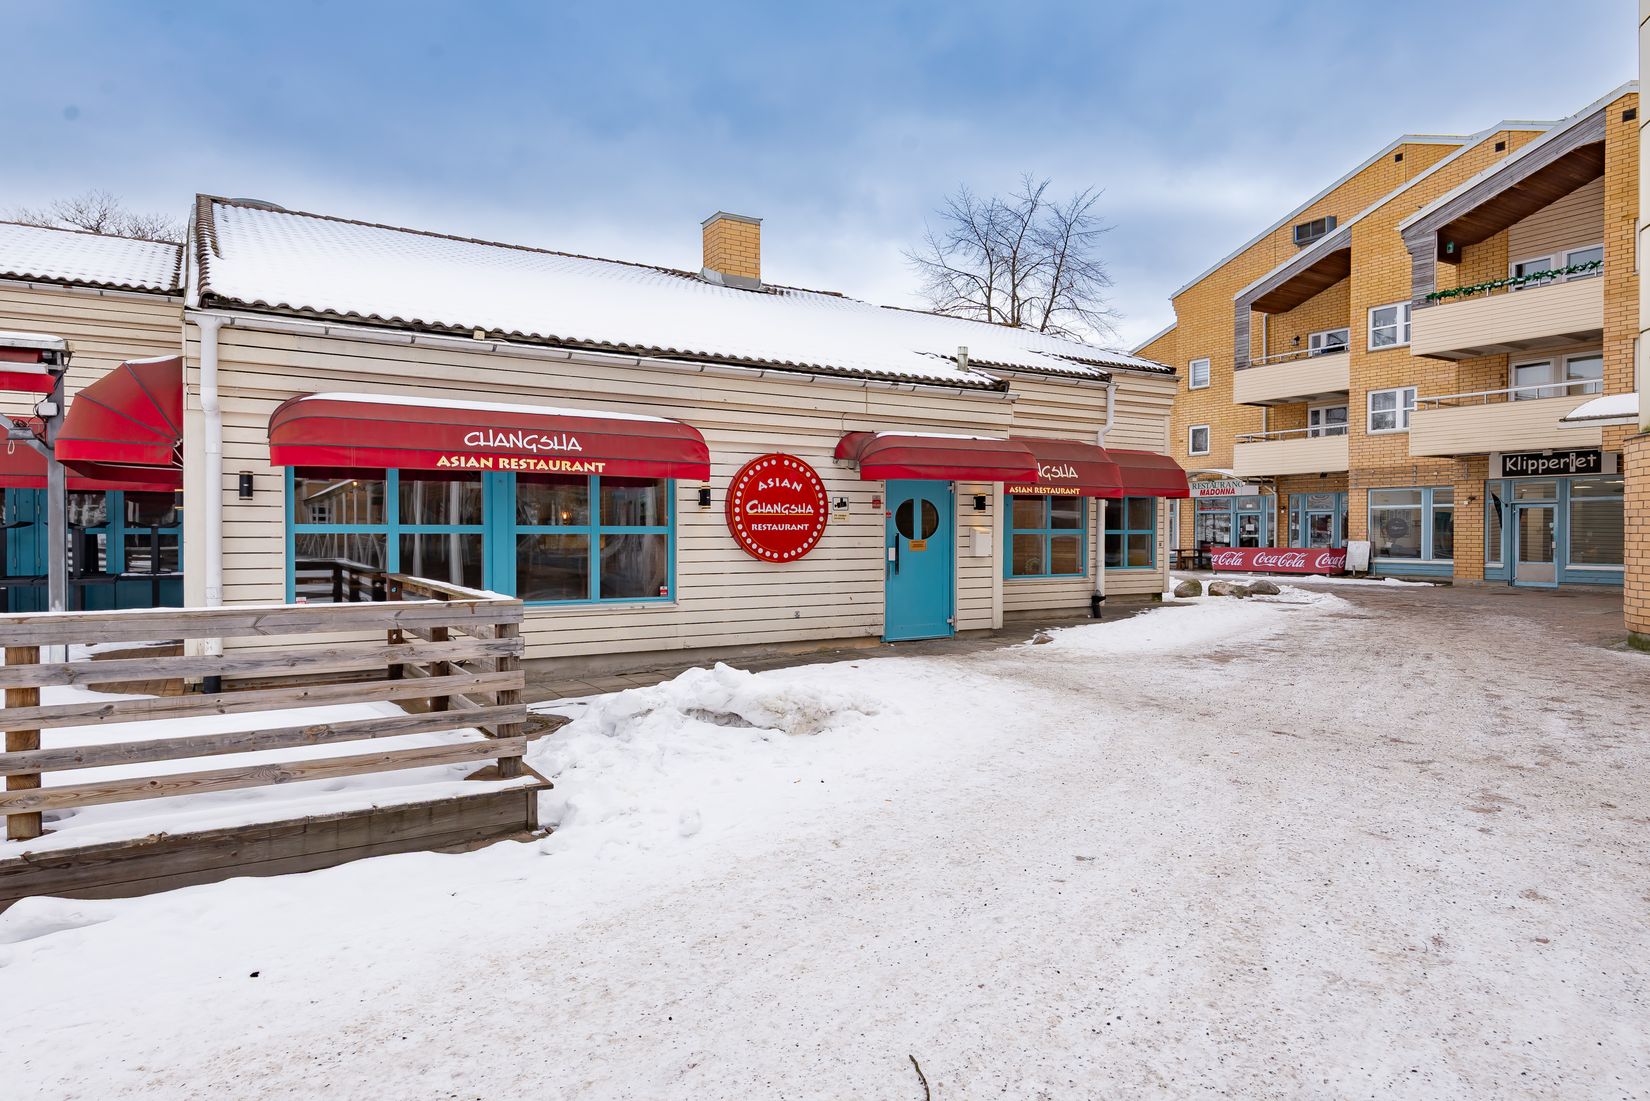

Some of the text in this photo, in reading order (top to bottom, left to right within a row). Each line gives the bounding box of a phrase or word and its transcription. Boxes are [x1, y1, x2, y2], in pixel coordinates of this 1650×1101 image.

[464, 429, 583, 453] CHANGSHA
[436, 455, 606, 473] ASIAN RESTAURANT
[1037, 462, 1079, 481] NGSHA
[758, 477, 803, 492] ASIAN
[1009, 486, 1081, 495] ASIAN RESTAURANT
[1200, 488, 1236, 496] MADONNA
[746, 500, 814, 516] CHANGSHA
[751, 523, 810, 531] RESTAURANT
[1252, 551, 1309, 568] Coca-Cola
